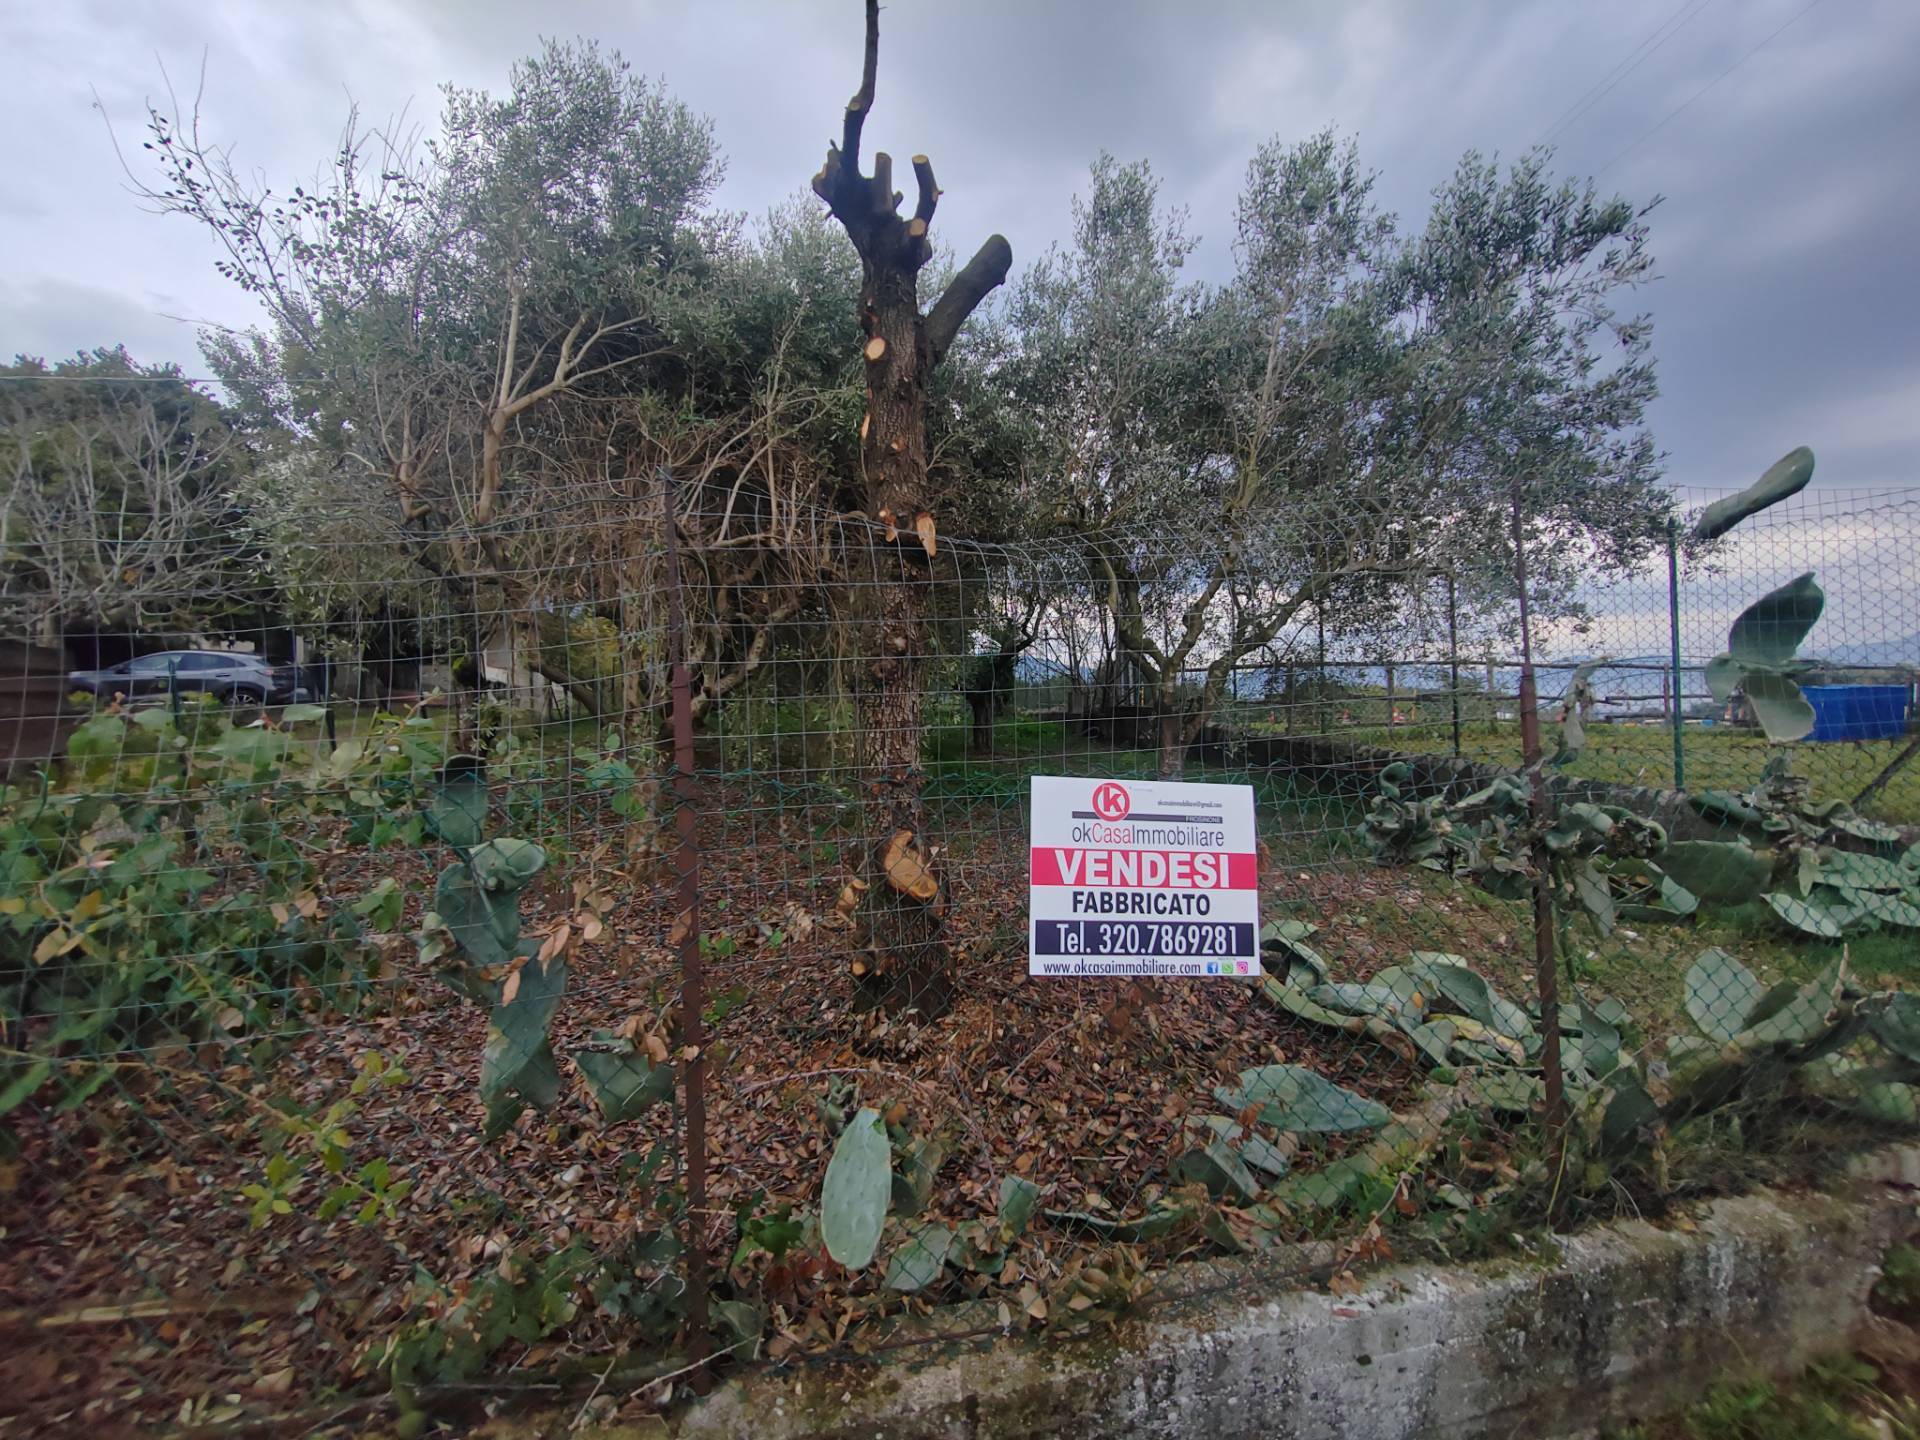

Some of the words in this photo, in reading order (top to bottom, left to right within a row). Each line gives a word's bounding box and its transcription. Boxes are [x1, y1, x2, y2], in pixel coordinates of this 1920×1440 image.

[1072, 823, 1225, 847] okCasaImmobiliare
[1055, 850, 1230, 888] VENDESI
[1072, 891, 1211, 916] FABBRICATO
[1056, 922, 1092, 954] Tel.
[1099, 924, 1237, 955] 320.7869281
[1043, 958, 1201, 975] www.okcasaimmobiliare.com
